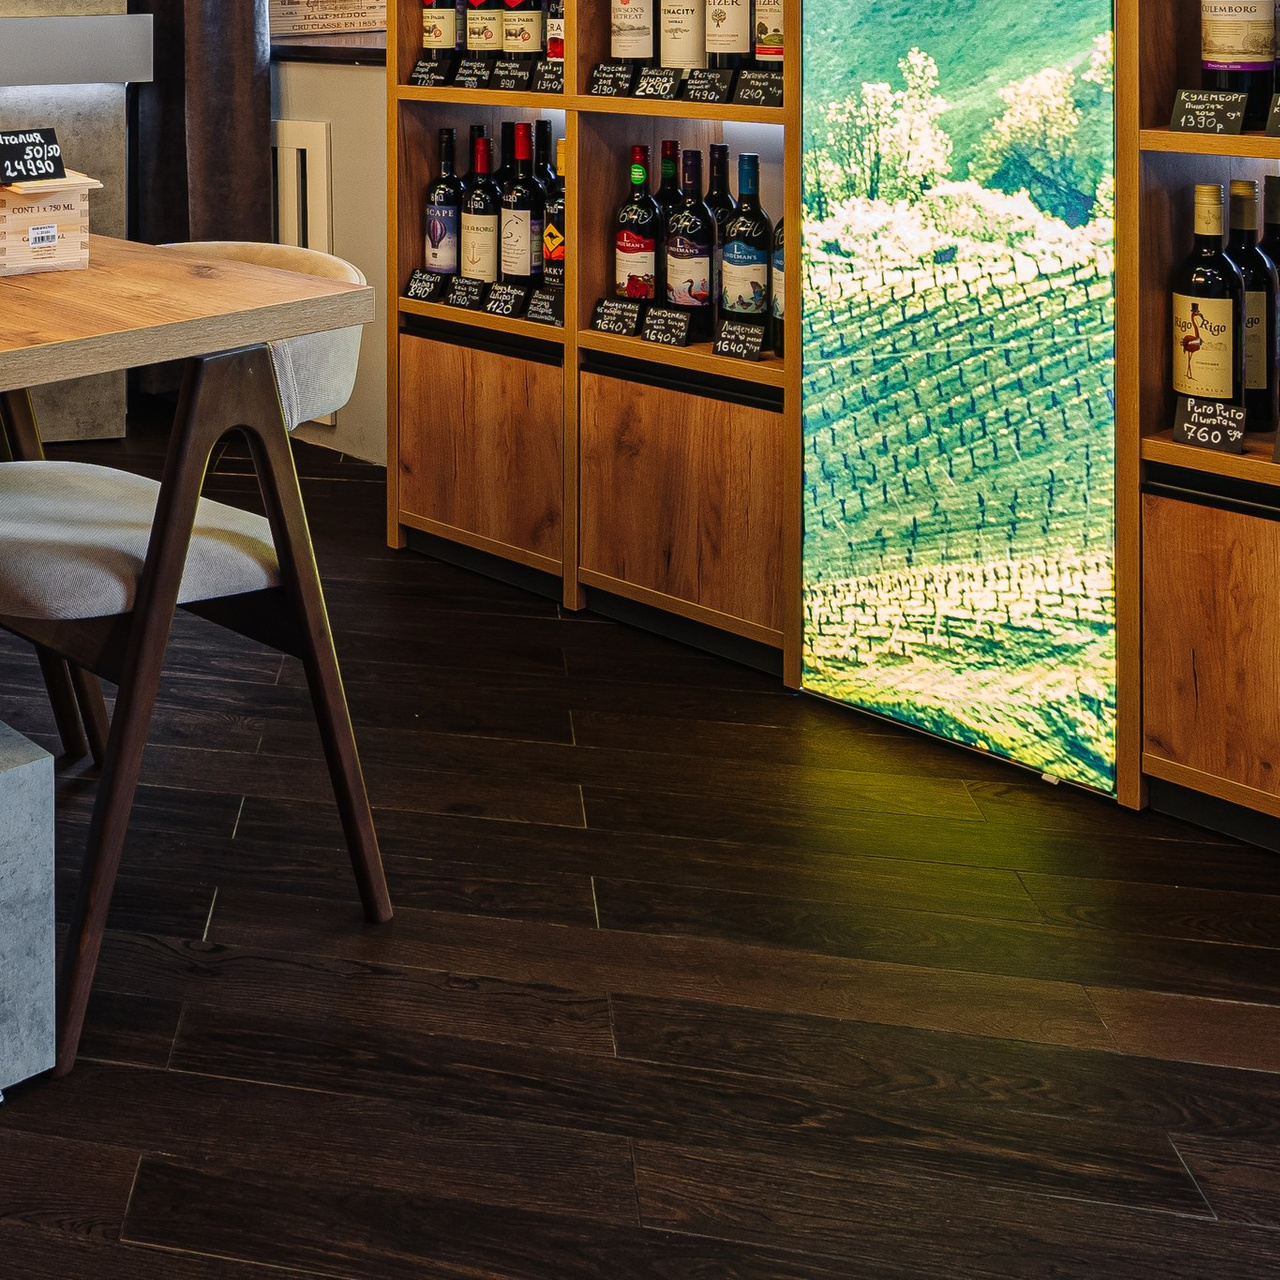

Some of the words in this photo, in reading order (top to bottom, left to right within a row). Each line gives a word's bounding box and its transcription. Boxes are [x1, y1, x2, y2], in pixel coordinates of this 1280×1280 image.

[24, 145, 60, 160] 50/50
[5, 160, 54, 177] 24990
[12, 206, 35, 214] CONT
[63, 203, 75, 211] ML
[1175, 317, 1192, 332] Rigo
[1200, 320, 1226, 336] Rigo
[1184, 424, 1221, 443] 760
